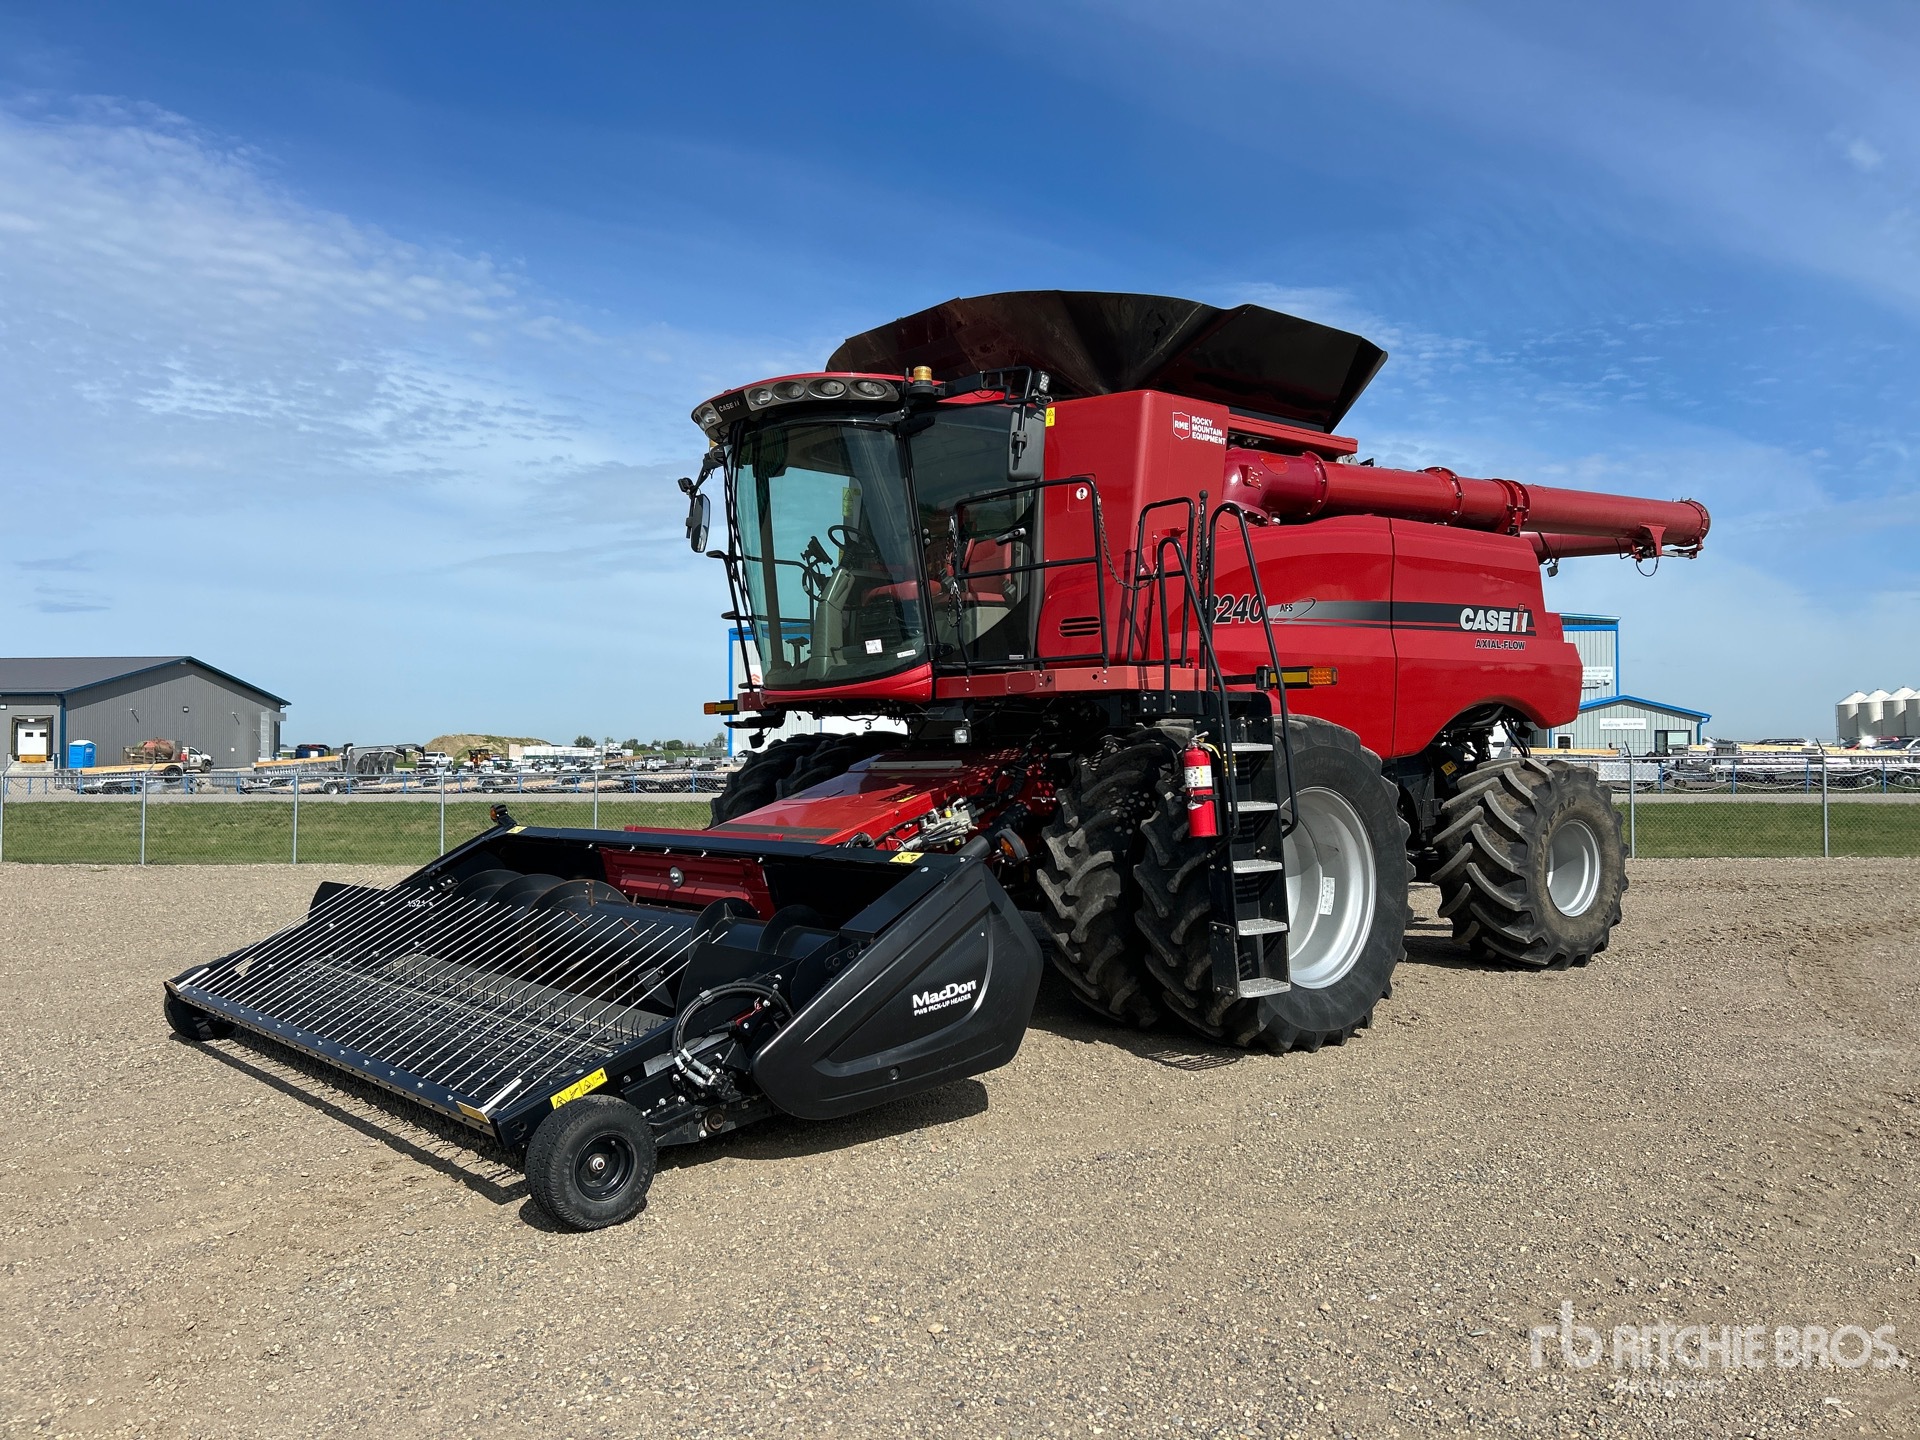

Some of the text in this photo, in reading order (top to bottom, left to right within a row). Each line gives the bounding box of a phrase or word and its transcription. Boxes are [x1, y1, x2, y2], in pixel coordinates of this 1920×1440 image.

[718, 401, 734, 412] CASE
[1174, 420, 1189, 430] RME
[1191, 415, 1213, 427] ROCKY
[1191, 423, 1223, 437] MOUNTAIN
[1191, 431, 1227, 445] EQUIPMENT
[1279, 603, 1293, 612] AFS
[1460, 607, 1511, 632] CASE
[1475, 638, 1526, 650] AXIAL-FLOW
[864, 720, 872, 731] 3
[912, 980, 977, 1009] MacDon
[928, 999, 951, 1012] PICK-UP
[950, 993, 972, 1005] HEADER
